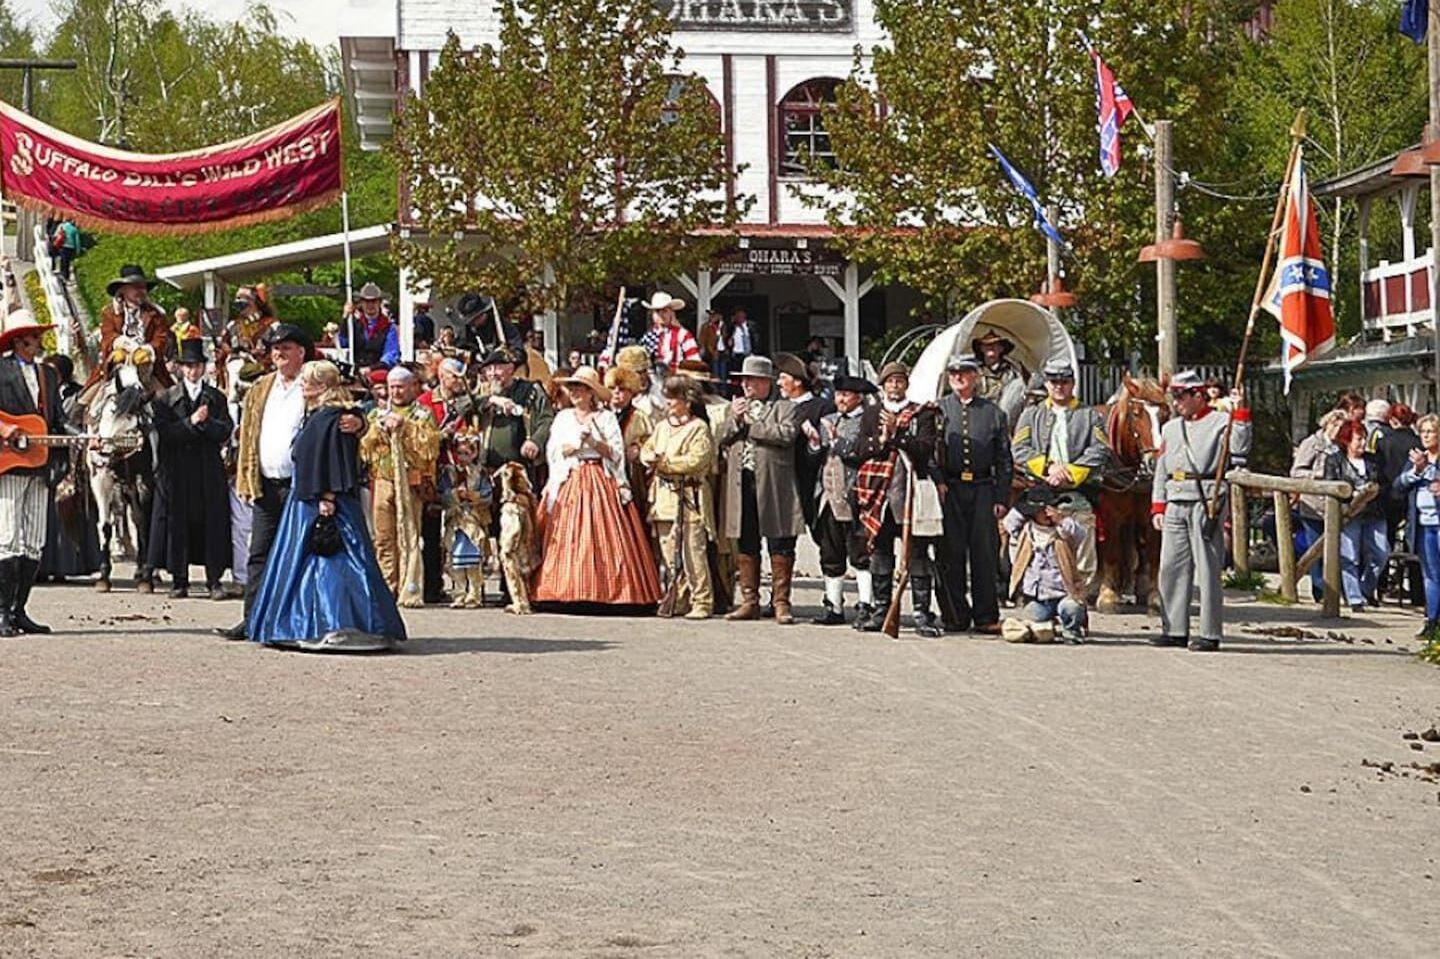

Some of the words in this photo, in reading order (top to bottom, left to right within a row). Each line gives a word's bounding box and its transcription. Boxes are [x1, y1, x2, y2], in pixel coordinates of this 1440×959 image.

[10, 130, 117, 183] BUFFALO
[200, 158, 261, 185] WILD
[263, 130, 331, 171] WEST
